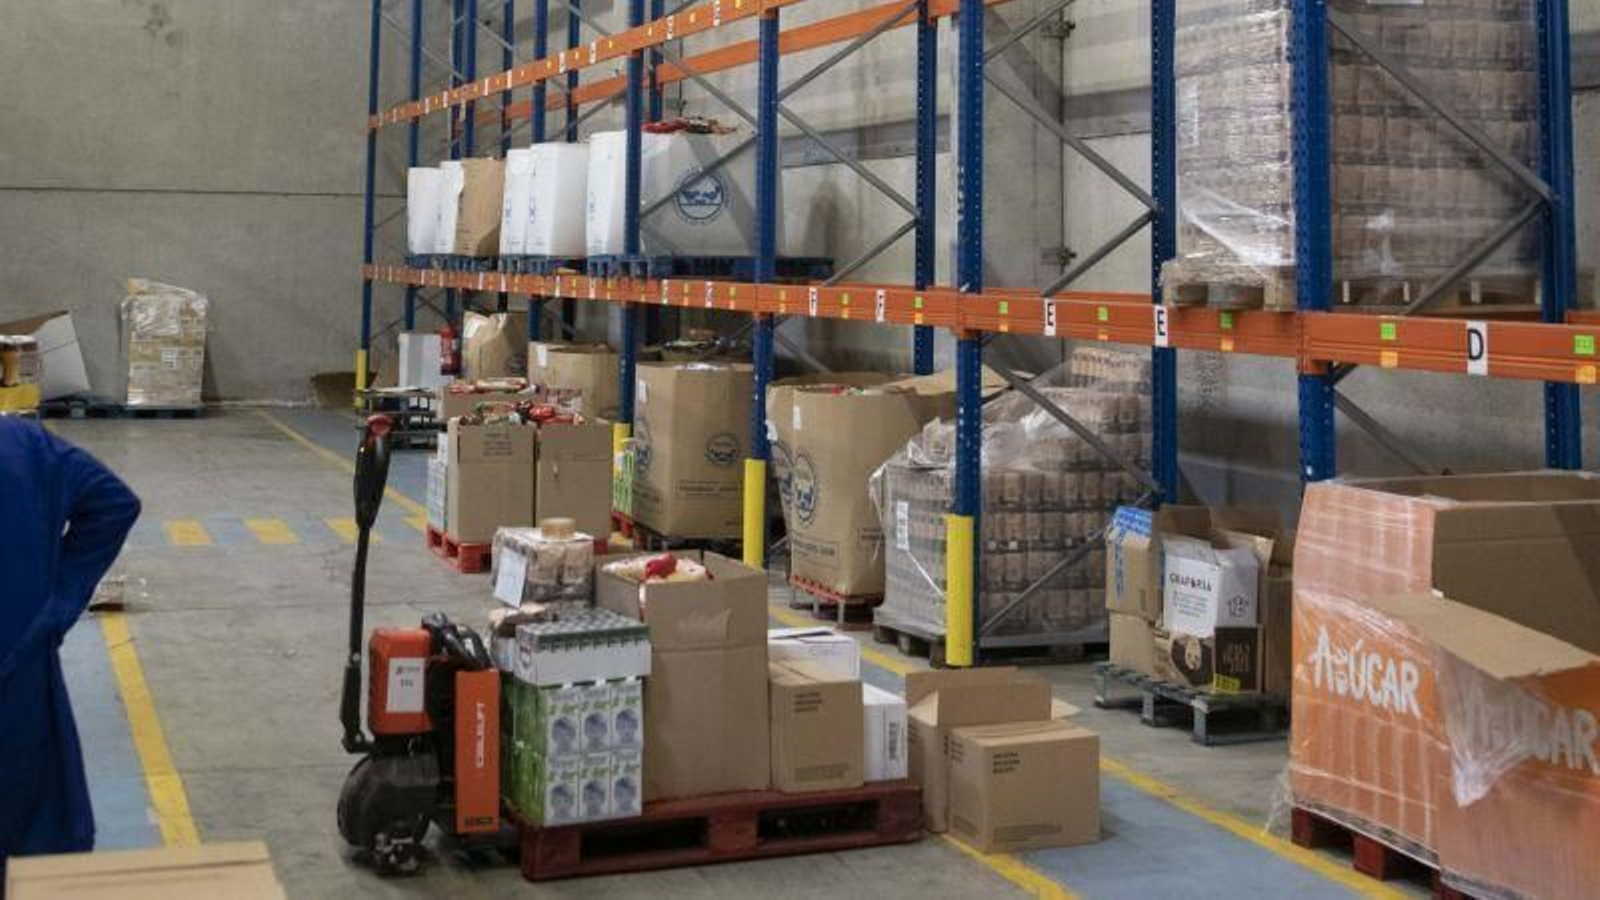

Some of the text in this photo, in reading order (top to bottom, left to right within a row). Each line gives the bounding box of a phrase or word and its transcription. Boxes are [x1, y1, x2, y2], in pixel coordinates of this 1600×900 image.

[1047, 302, 1054, 326] E
[1157, 309, 1166, 336] E
[1468, 328, 1484, 360] D
